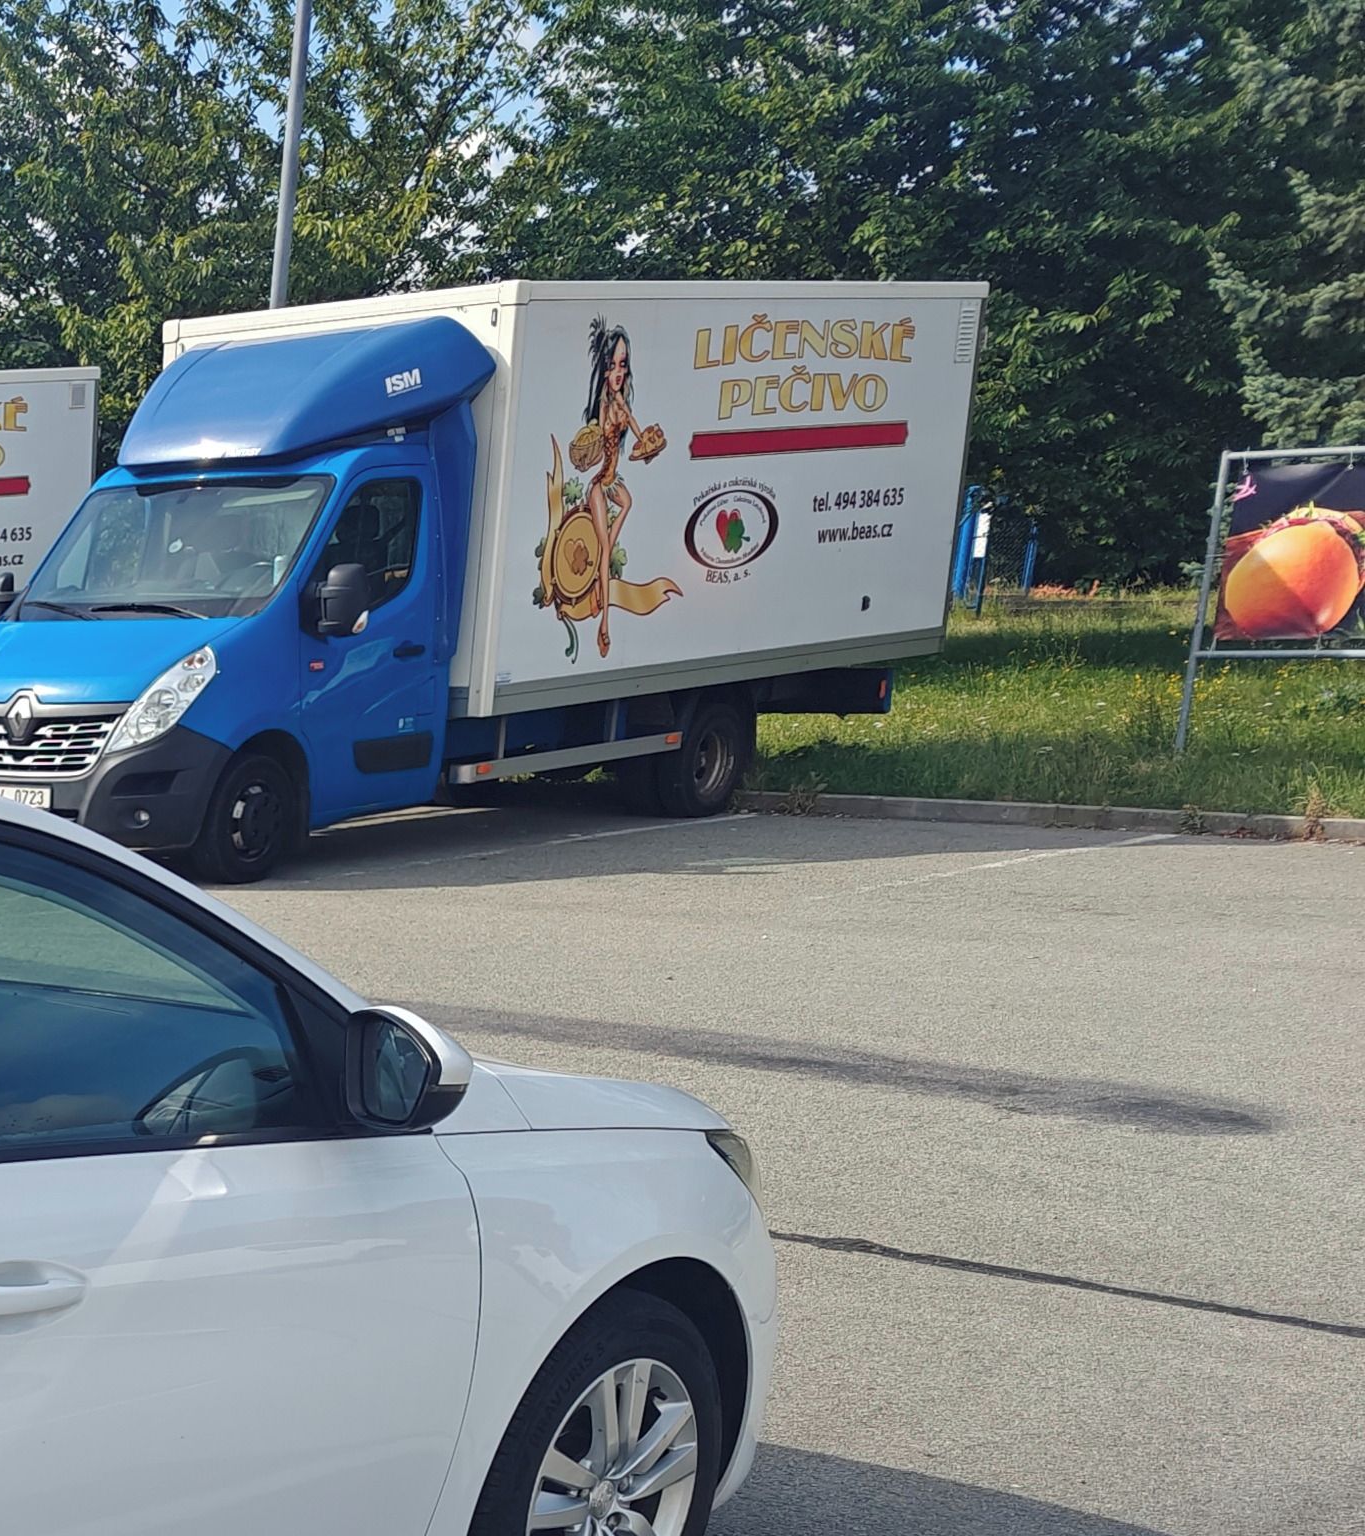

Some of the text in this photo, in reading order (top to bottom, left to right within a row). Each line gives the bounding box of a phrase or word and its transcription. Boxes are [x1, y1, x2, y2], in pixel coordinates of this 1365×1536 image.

[693, 313, 916, 370] LIČENSKÉ
[385, 367, 421, 394] ISM
[718, 365, 888, 420] PEČIVO
[813, 487, 904, 512] tel. 494 384 635
[10, 526, 32, 541] 635
[818, 520, 894, 544] www.beas.cz
[706, 569, 731, 584] BEAS,
[14, 789, 44, 806] 0723
